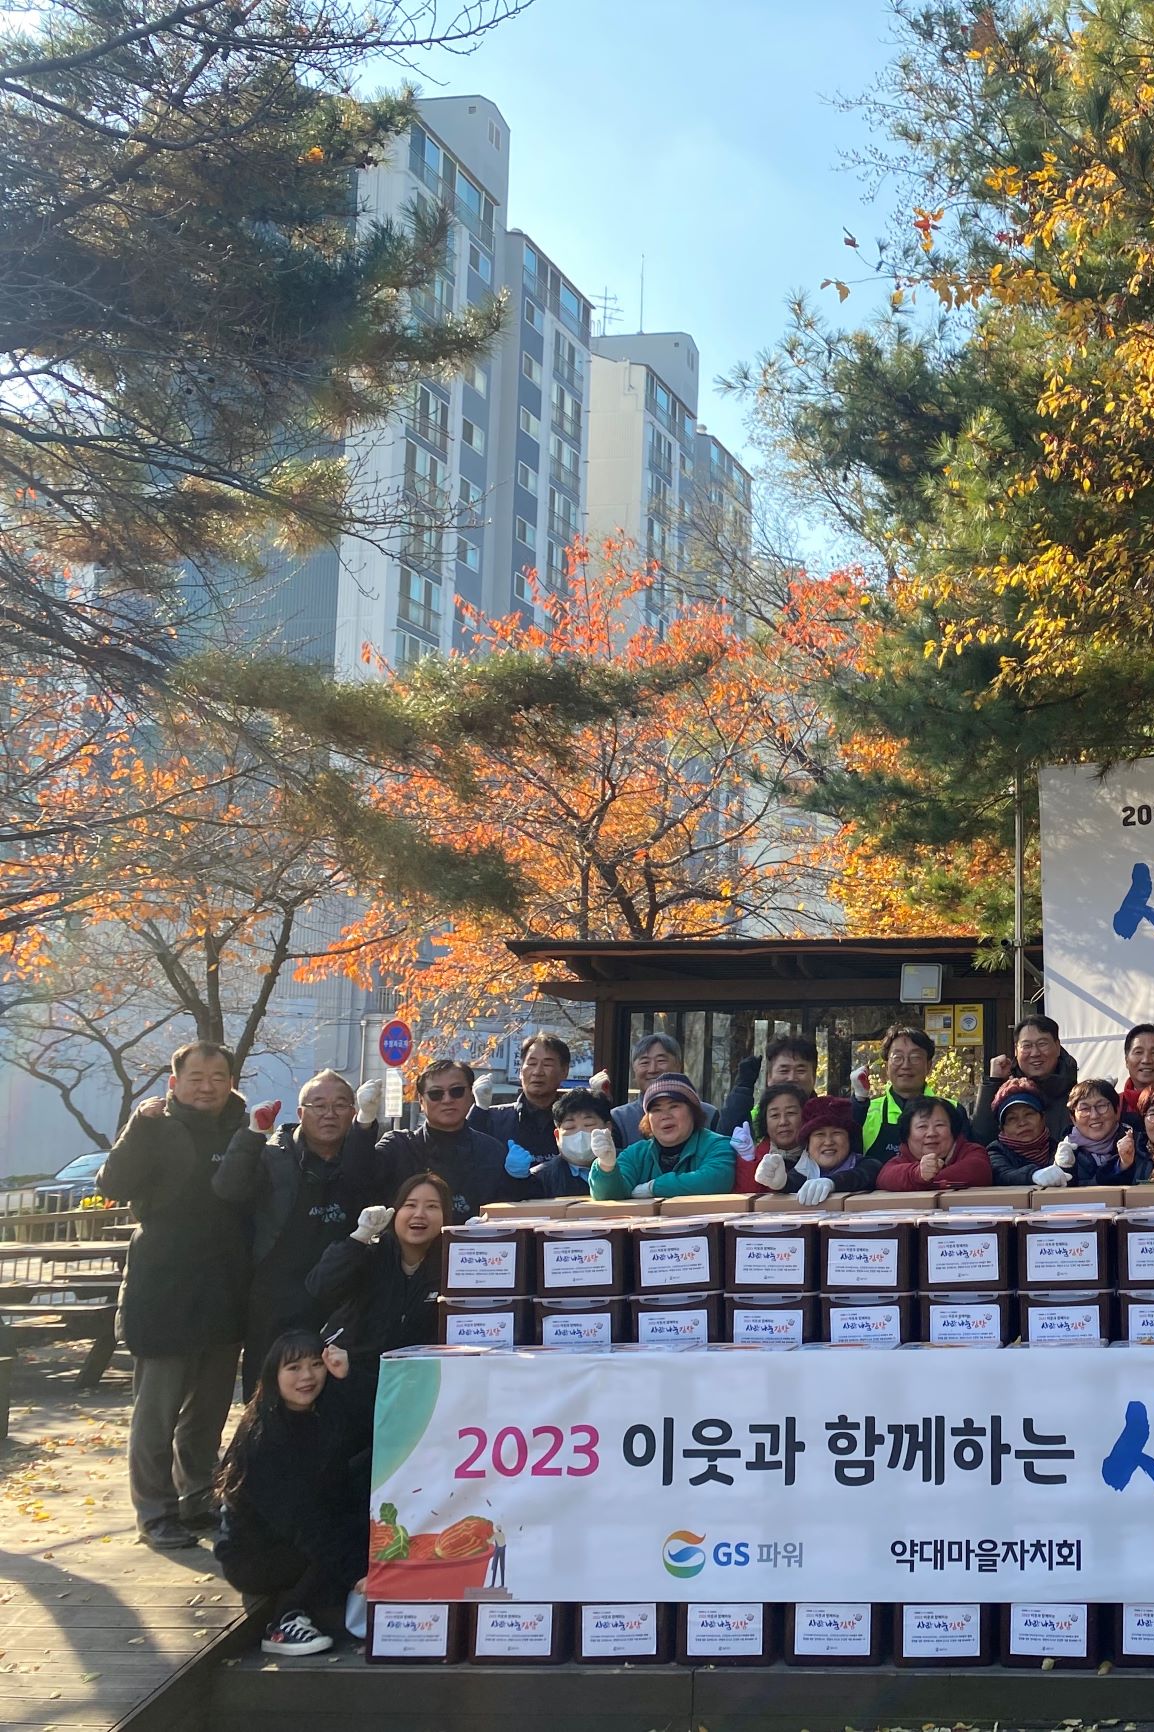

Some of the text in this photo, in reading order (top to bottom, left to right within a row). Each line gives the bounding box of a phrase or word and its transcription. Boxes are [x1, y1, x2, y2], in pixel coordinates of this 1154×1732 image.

[456, 1424, 600, 1479] 2023
[622, 1416, 806, 1486] 이웃과
[825, 1414, 1075, 1487] 함께하는
[712, 1542, 804, 1569] GS 파워
[891, 1539, 1082, 1573] 약대마을자치회
